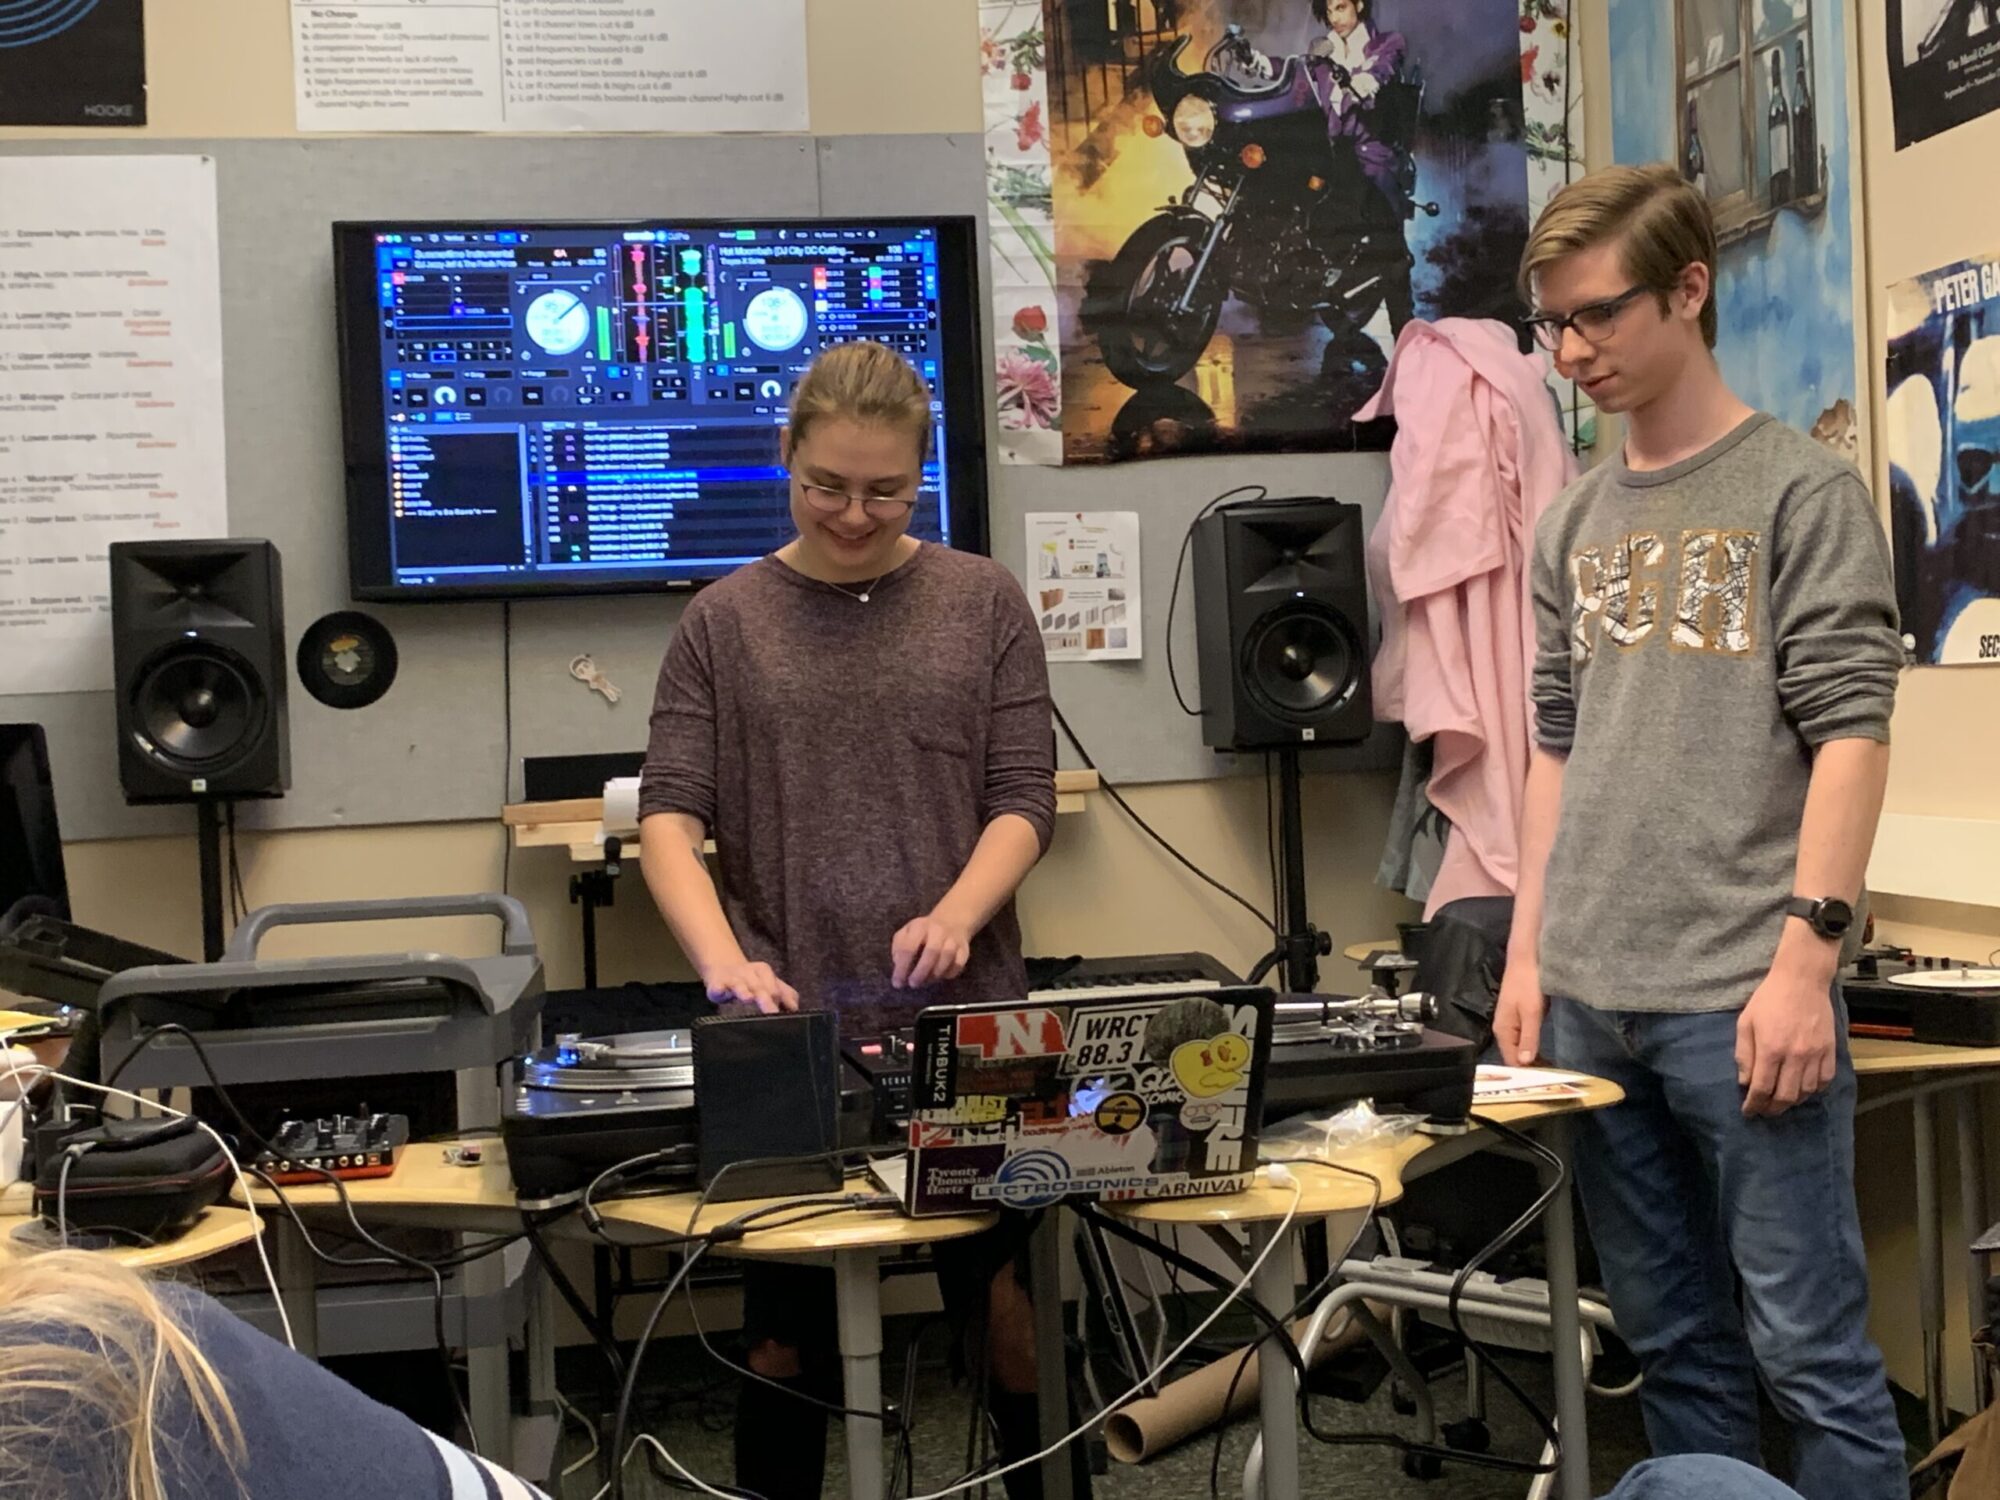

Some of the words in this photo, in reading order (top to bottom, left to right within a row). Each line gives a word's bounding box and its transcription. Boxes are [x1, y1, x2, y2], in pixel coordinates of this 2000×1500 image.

[1934, 268, 1980, 314] PETER
[993, 1011, 1047, 1055] N
[933, 1024, 951, 1102] TIMBUK2
[1076, 1041, 1133, 1067] 88.3
[927, 1174, 994, 1186] Thousand
[928, 1168, 979, 1177] Twenty
[1098, 1164, 1135, 1175] Ableton
[926, 1185, 965, 1195] Hertz
[974, 1177, 1160, 1198] LECTROSONICS
